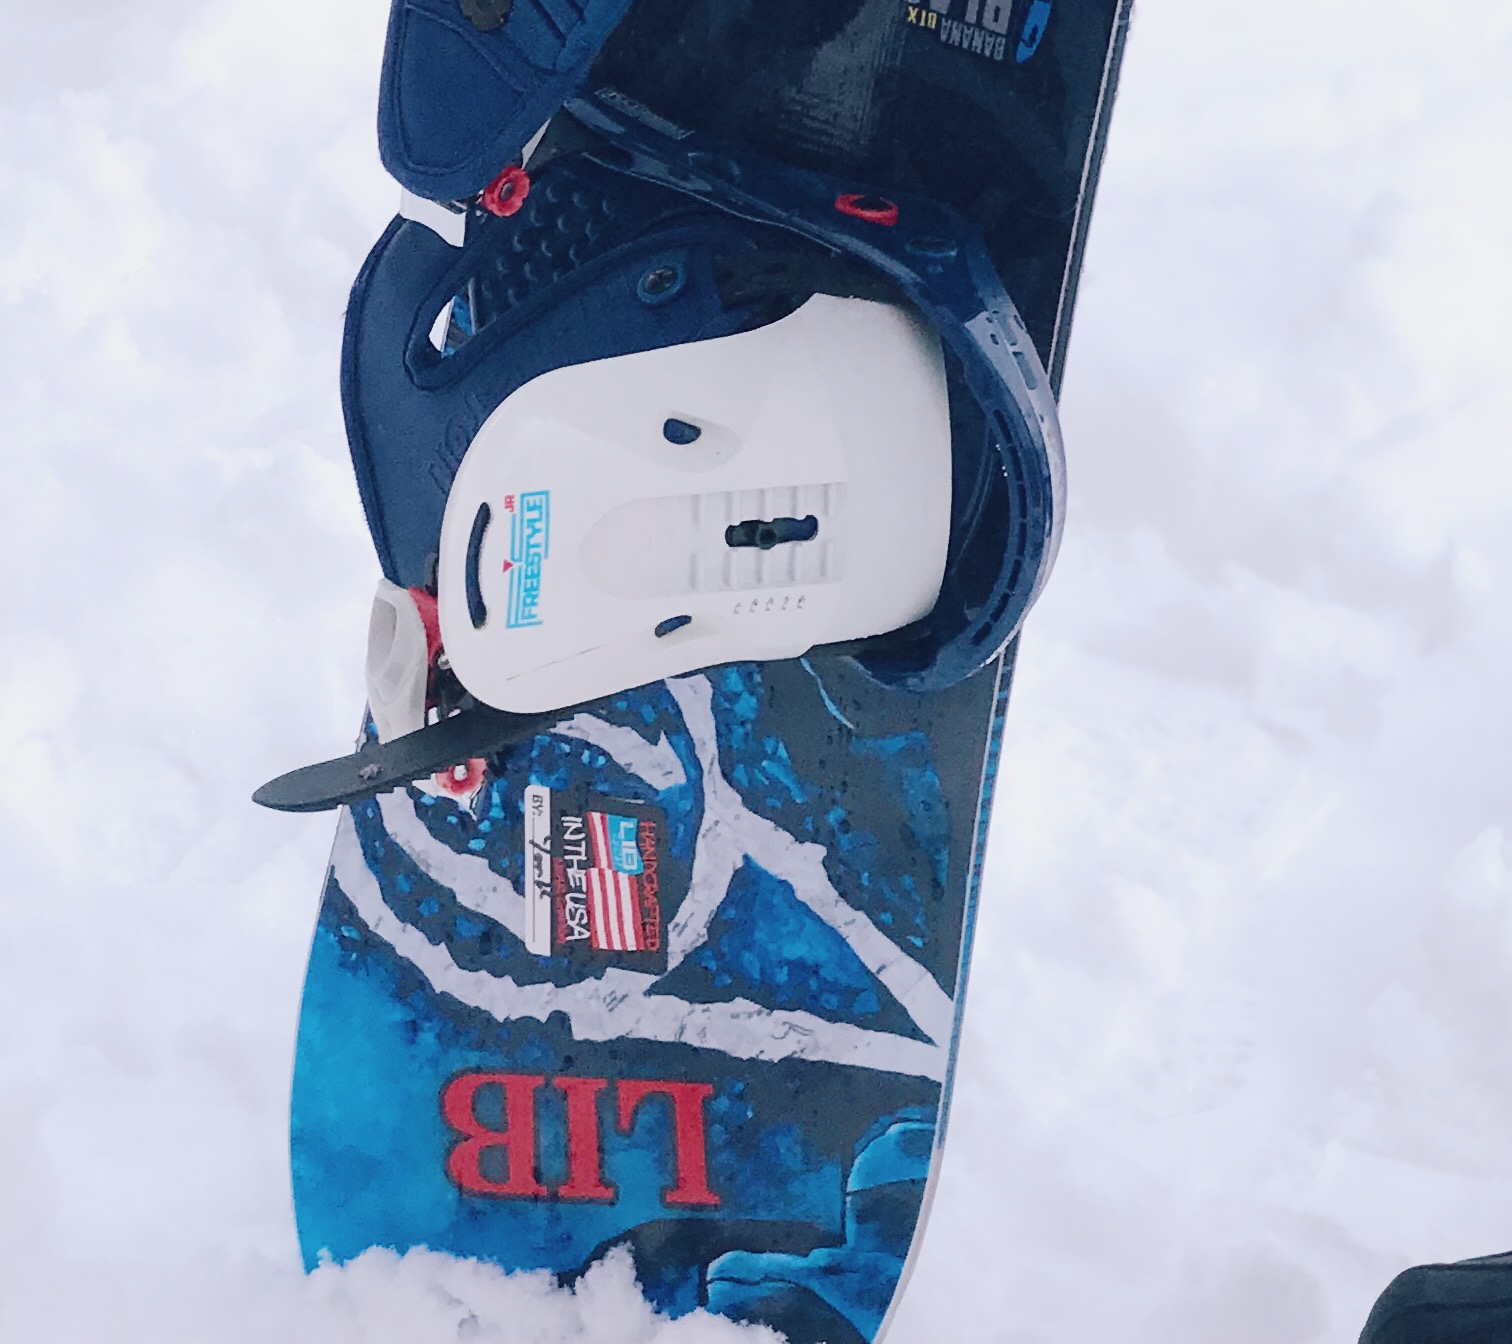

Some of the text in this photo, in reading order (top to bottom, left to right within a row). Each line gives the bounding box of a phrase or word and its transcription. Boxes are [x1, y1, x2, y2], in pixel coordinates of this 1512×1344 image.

[940, 17, 1006, 61] BANANA
[504, 494, 515, 512] JR
[521, 497, 543, 620] FREESTYLE
[532, 794, 543, 816] BY:
[619, 820, 638, 870] LIB
[639, 820, 660, 951] HANDCRAFTED
[564, 892, 591, 941] USA
[442, 1072, 721, 1207] LIB
